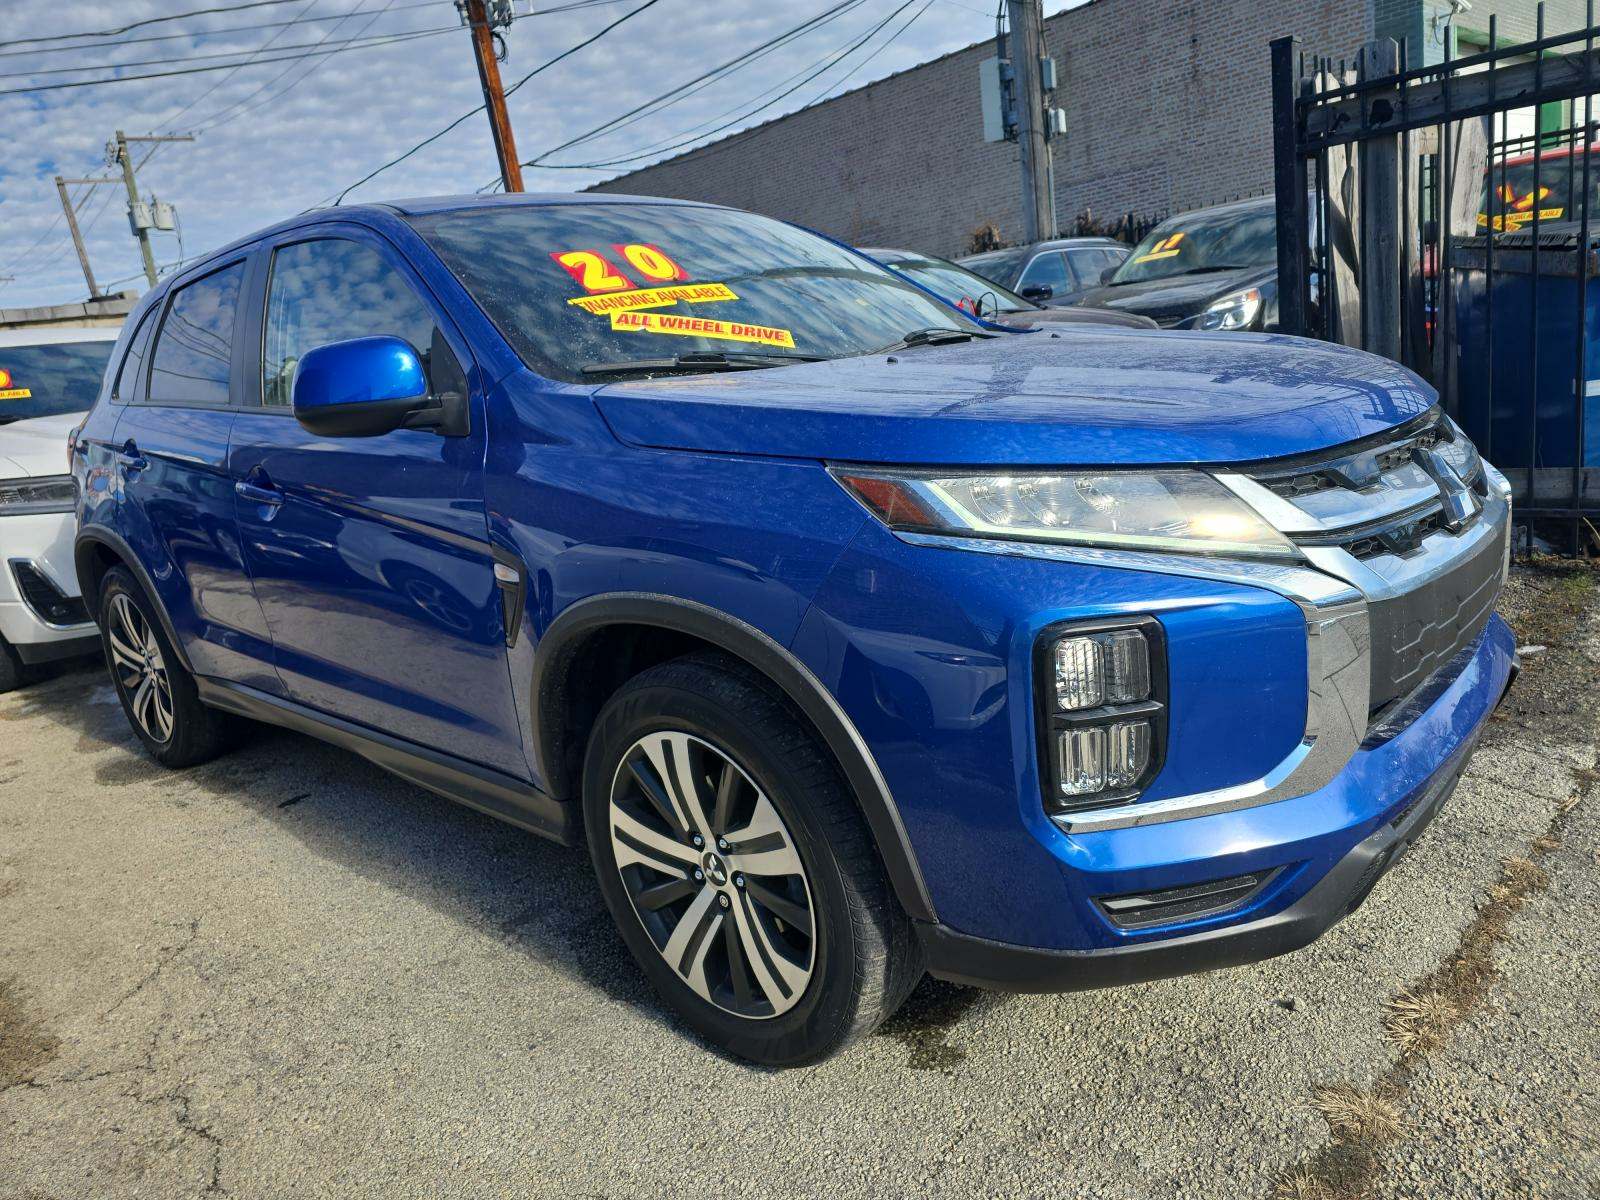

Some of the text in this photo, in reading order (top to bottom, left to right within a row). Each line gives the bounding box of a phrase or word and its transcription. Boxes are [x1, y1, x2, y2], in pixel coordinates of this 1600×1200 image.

[557, 244, 681, 291] 20
[656, 286, 731, 303] AVAILABLE
[615, 313, 786, 341] ALL WHEEL DRIVE
